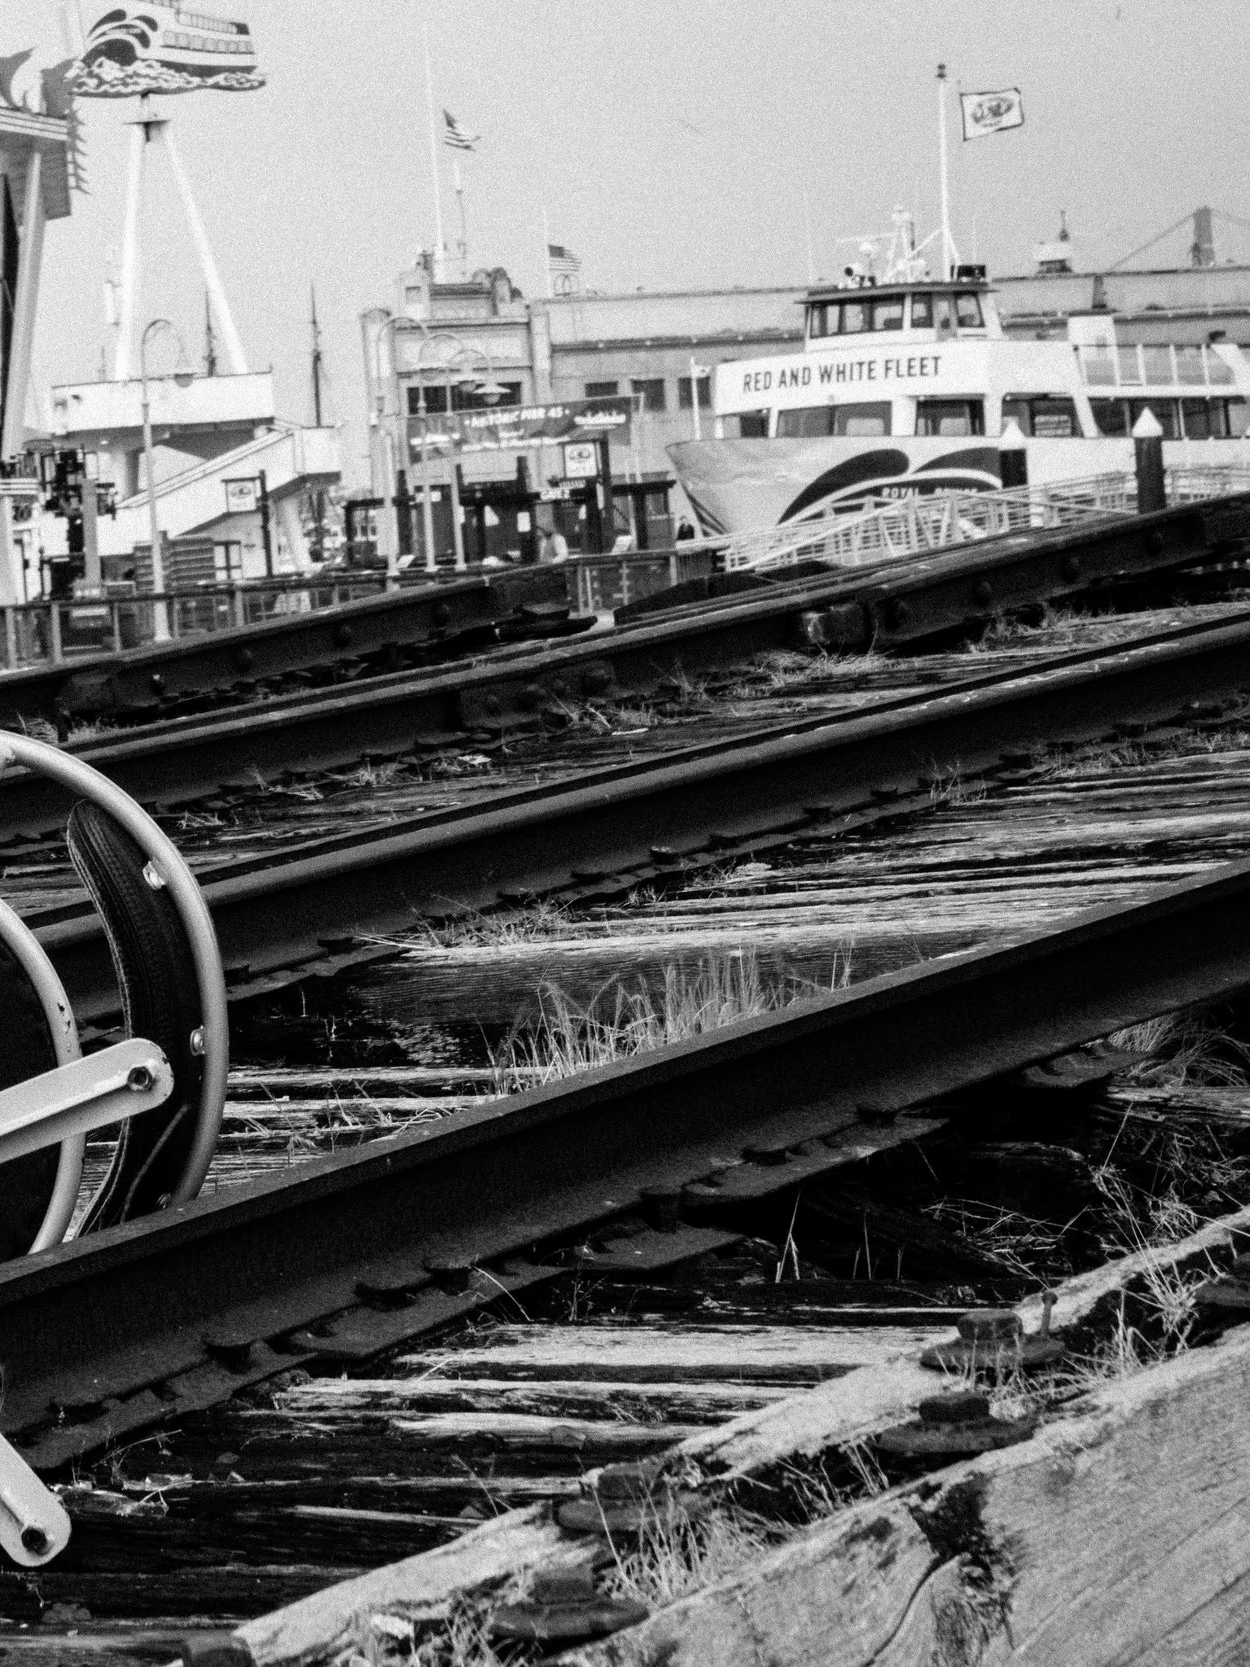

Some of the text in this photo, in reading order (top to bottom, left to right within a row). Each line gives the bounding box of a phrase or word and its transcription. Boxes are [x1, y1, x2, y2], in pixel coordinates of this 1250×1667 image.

[743, 356, 942, 393] RED AND WHITE FLEET
